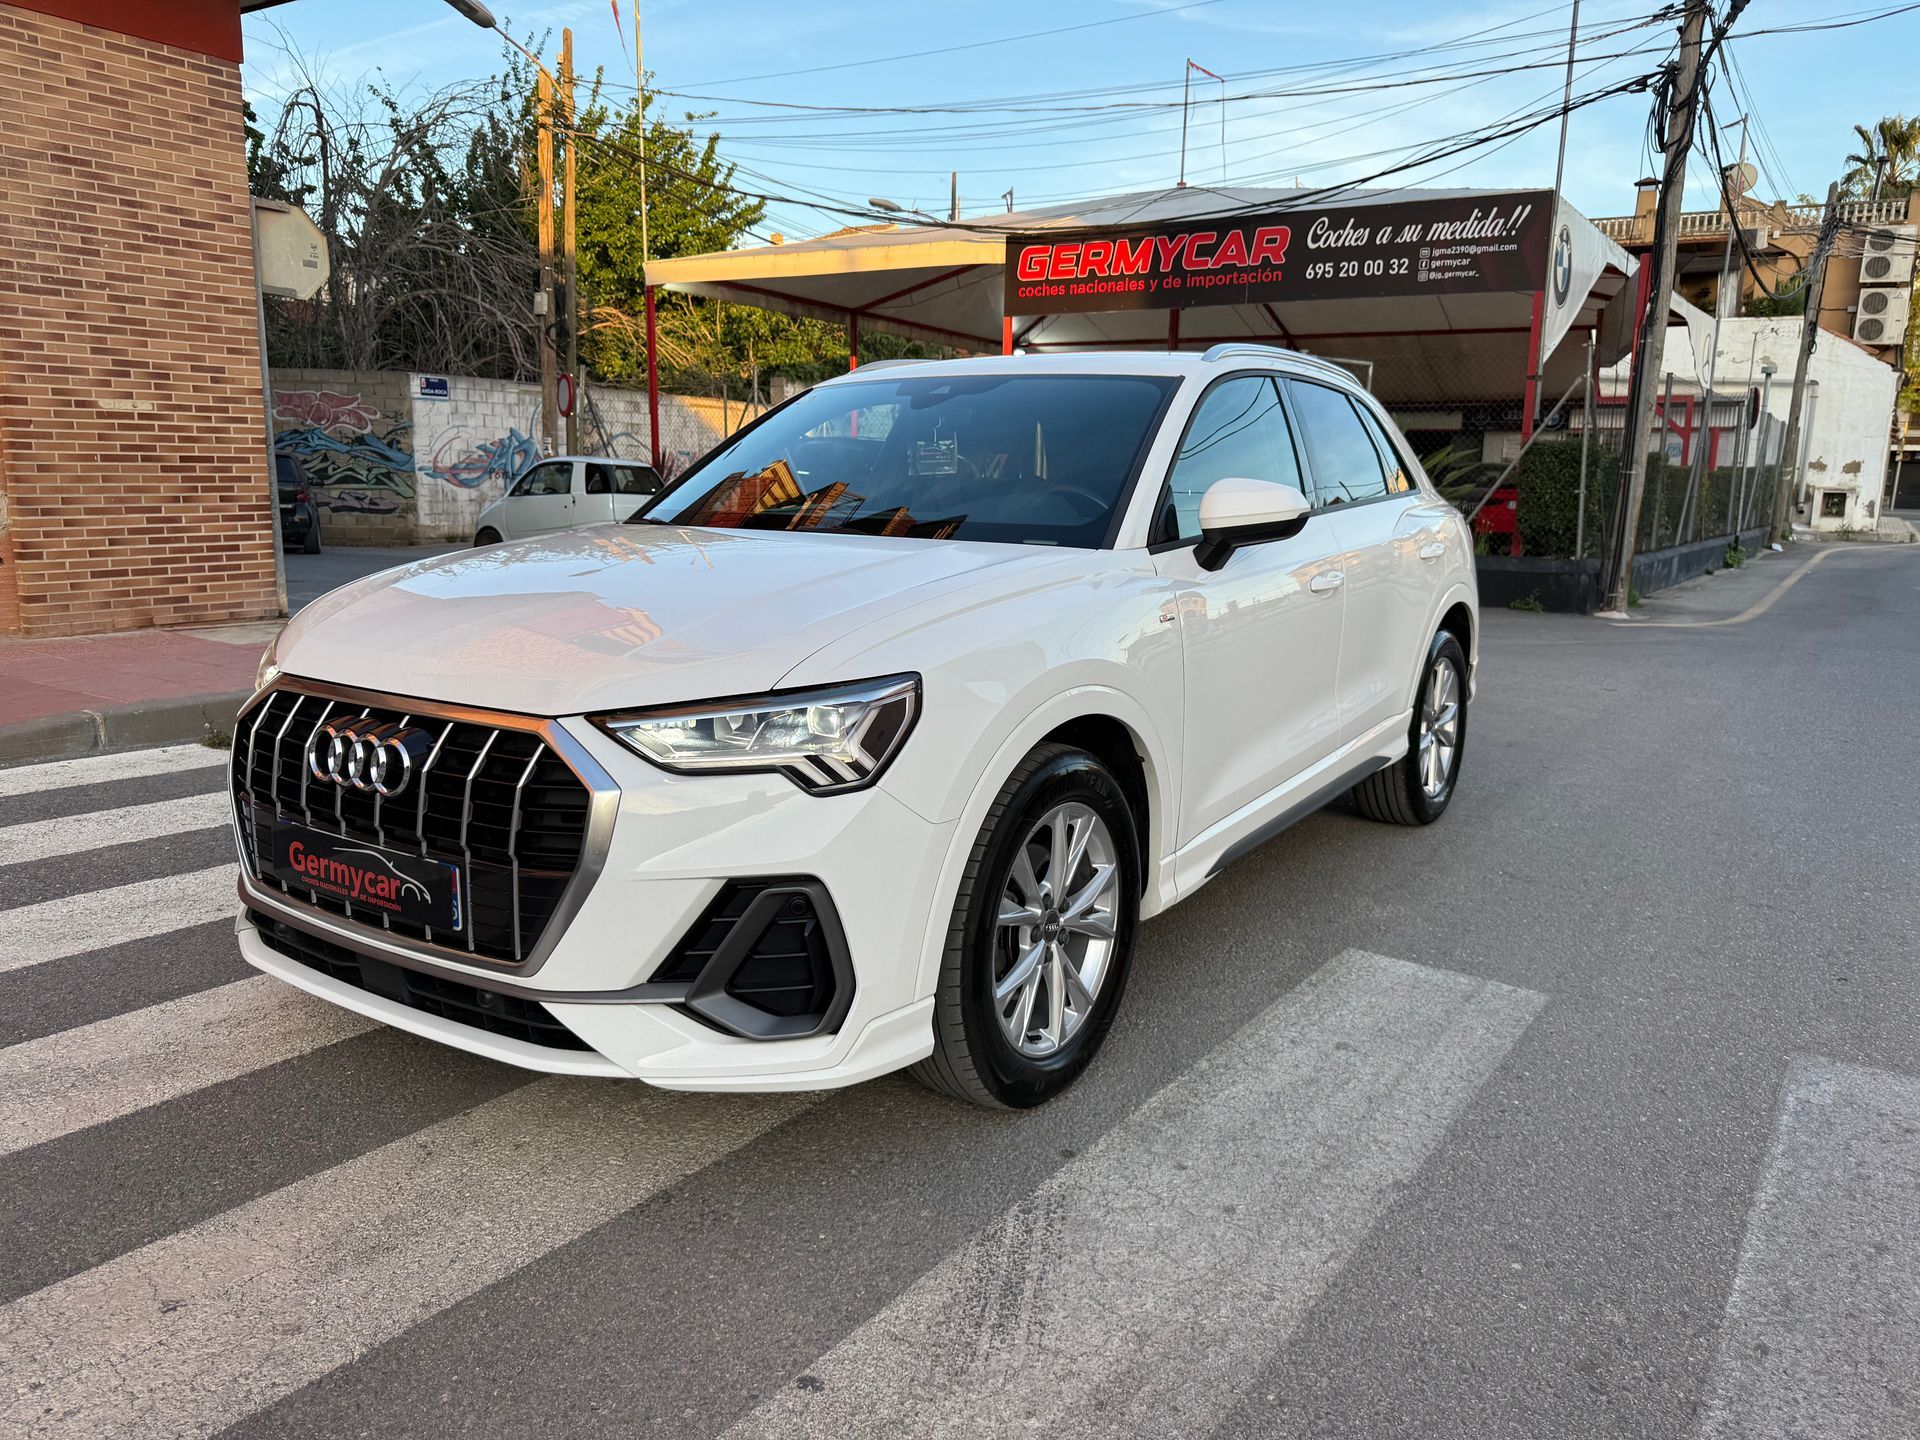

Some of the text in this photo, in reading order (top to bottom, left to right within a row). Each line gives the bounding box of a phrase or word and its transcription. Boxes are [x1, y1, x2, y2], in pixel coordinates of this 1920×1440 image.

[1306, 204, 1532, 249] Coches a su medida!!
[1016, 225, 1291, 282] GERMYCAR
[1430, 258, 1471, 269] germycar
[1432, 243, 1518, 257] jgma2390@gmail.com
[1018, 267, 1283, 298] coches nacionales y de importación
[1305, 258, 1409, 279] 695 20 00 32
[289, 841, 401, 899] Germycar
